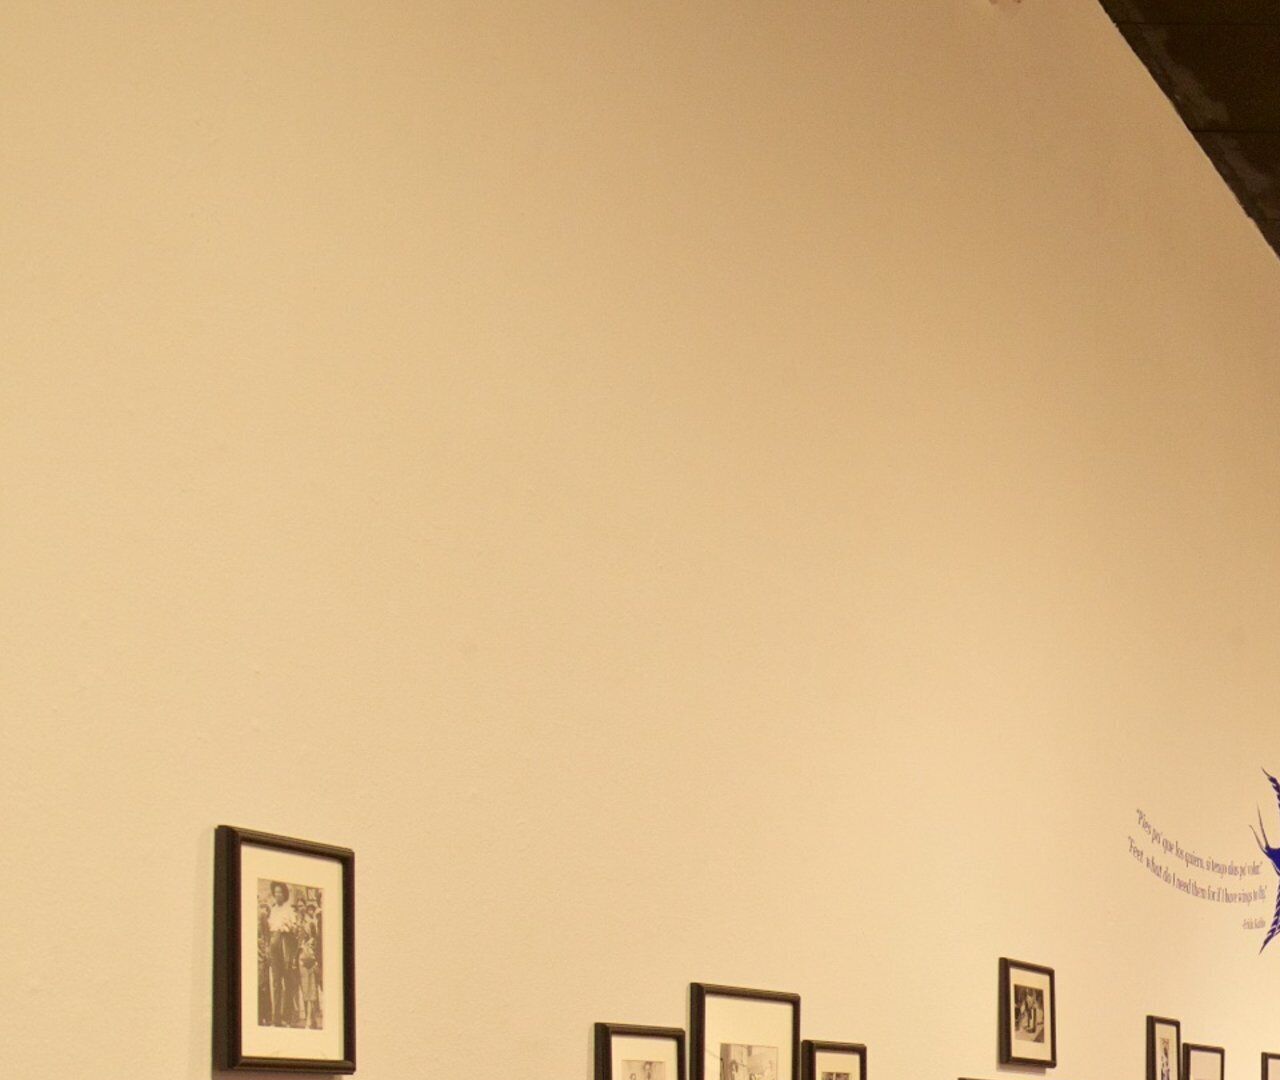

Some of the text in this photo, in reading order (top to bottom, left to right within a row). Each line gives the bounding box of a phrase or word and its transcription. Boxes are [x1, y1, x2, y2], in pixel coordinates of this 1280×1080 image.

[1146, 856, 1162, 878] what
[1162, 866, 1172, 884] do
[1176, 877, 1191, 894] need
[1191, 880, 1207, 899] them
